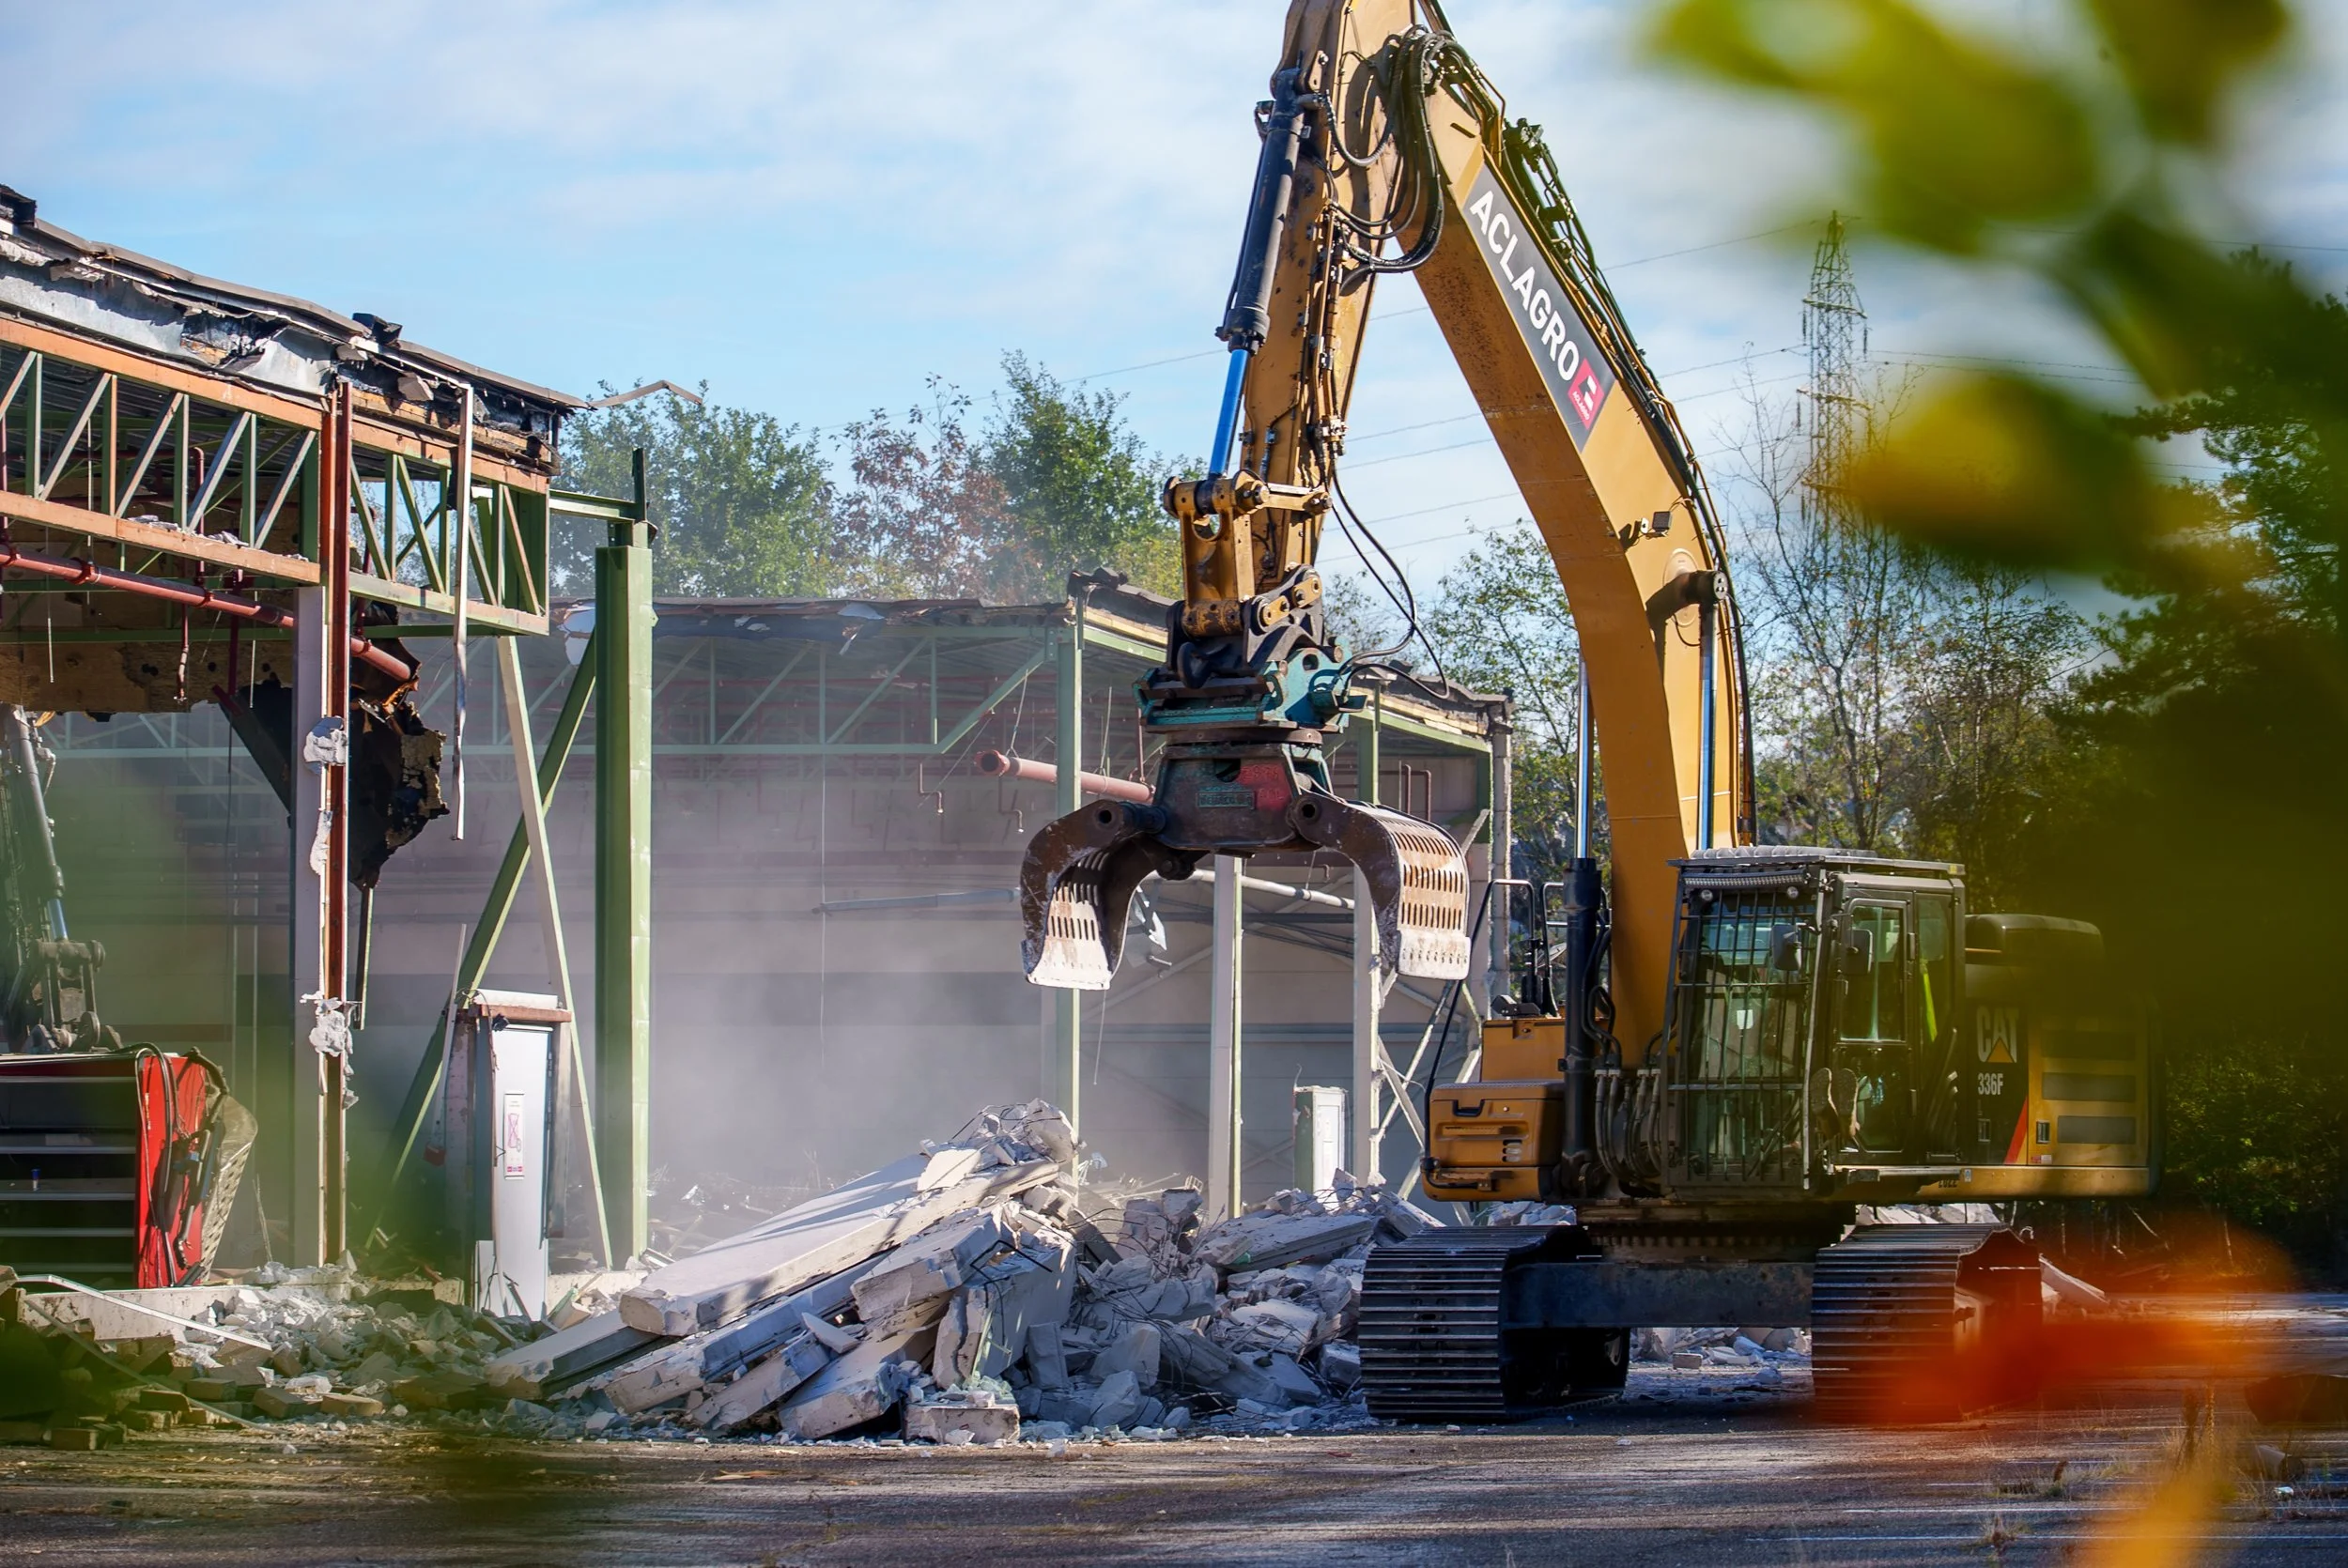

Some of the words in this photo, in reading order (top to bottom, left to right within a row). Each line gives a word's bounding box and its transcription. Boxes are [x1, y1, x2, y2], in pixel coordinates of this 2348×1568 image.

[1470, 190, 1580, 381] ACLAGRO
[1976, 1005, 2019, 1064] CAT
[1977, 1072, 2004, 1096] 336F
